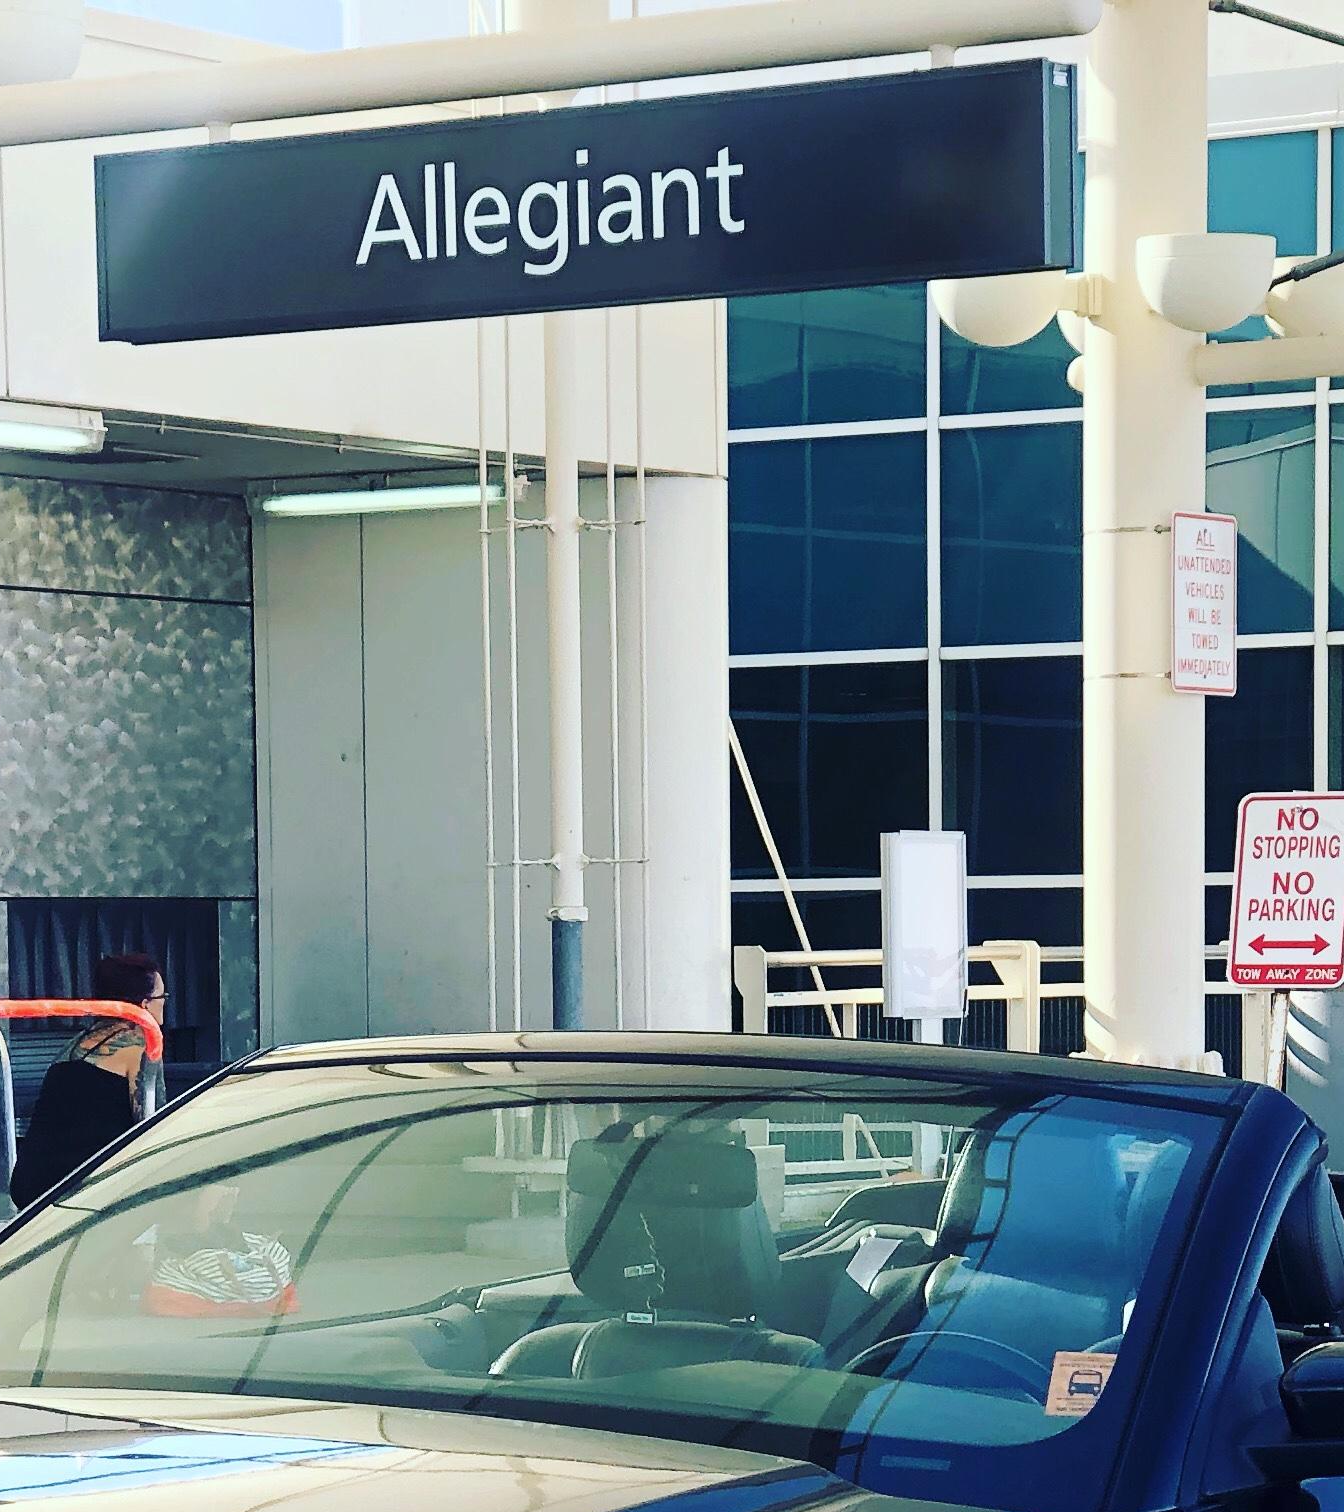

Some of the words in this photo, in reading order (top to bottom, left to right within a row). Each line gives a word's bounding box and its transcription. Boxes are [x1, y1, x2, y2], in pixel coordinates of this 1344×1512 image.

[356, 146, 745, 275] Allegiant
[1196, 530, 1216, 547] ALL
[1178, 555, 1232, 575] UNATTENDED
[1185, 582, 1225, 600] VEHICLES
[1188, 607, 1207, 624] WILL
[1211, 609, 1222, 625] BE
[1192, 633, 1219, 650] TOWED
[1178, 658, 1231, 676] IMMEDIATELY
[1277, 807, 1319, 831] NO
[1252, 835, 1341, 860] STOPPING
[1272, 872, 1315, 895] NO
[1248, 897, 1335, 922] PARKING
[1236, 968, 1262, 981] TOW
[1266, 968, 1301, 981] AWAY
[1305, 968, 1339, 981] ZONE
